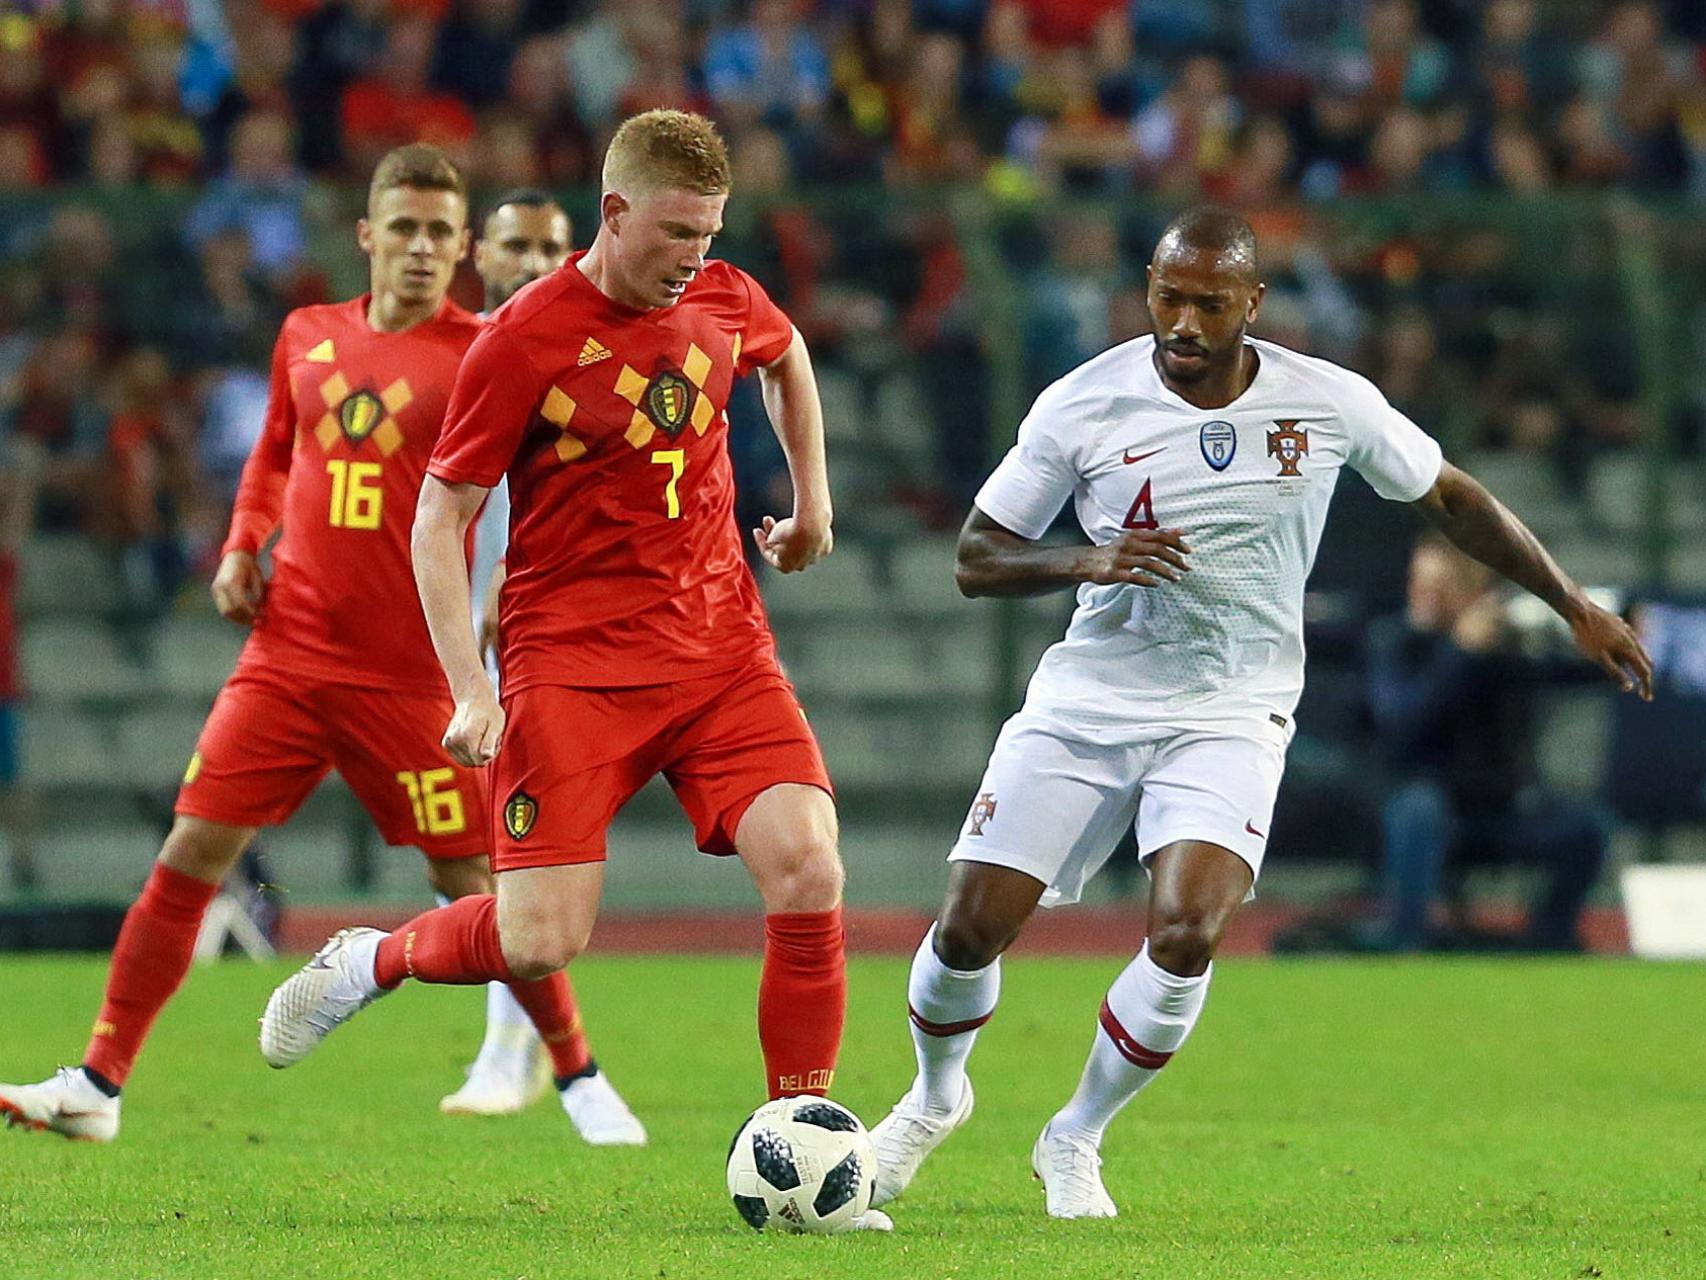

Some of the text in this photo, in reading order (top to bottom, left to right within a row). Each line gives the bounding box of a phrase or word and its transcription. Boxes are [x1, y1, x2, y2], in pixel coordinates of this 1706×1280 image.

[577, 349, 613, 367] adidas
[326, 459, 383, 529] 16
[651, 449, 684, 519] 7
[1121, 476, 1159, 530] 4
[396, 767, 466, 835] 16
